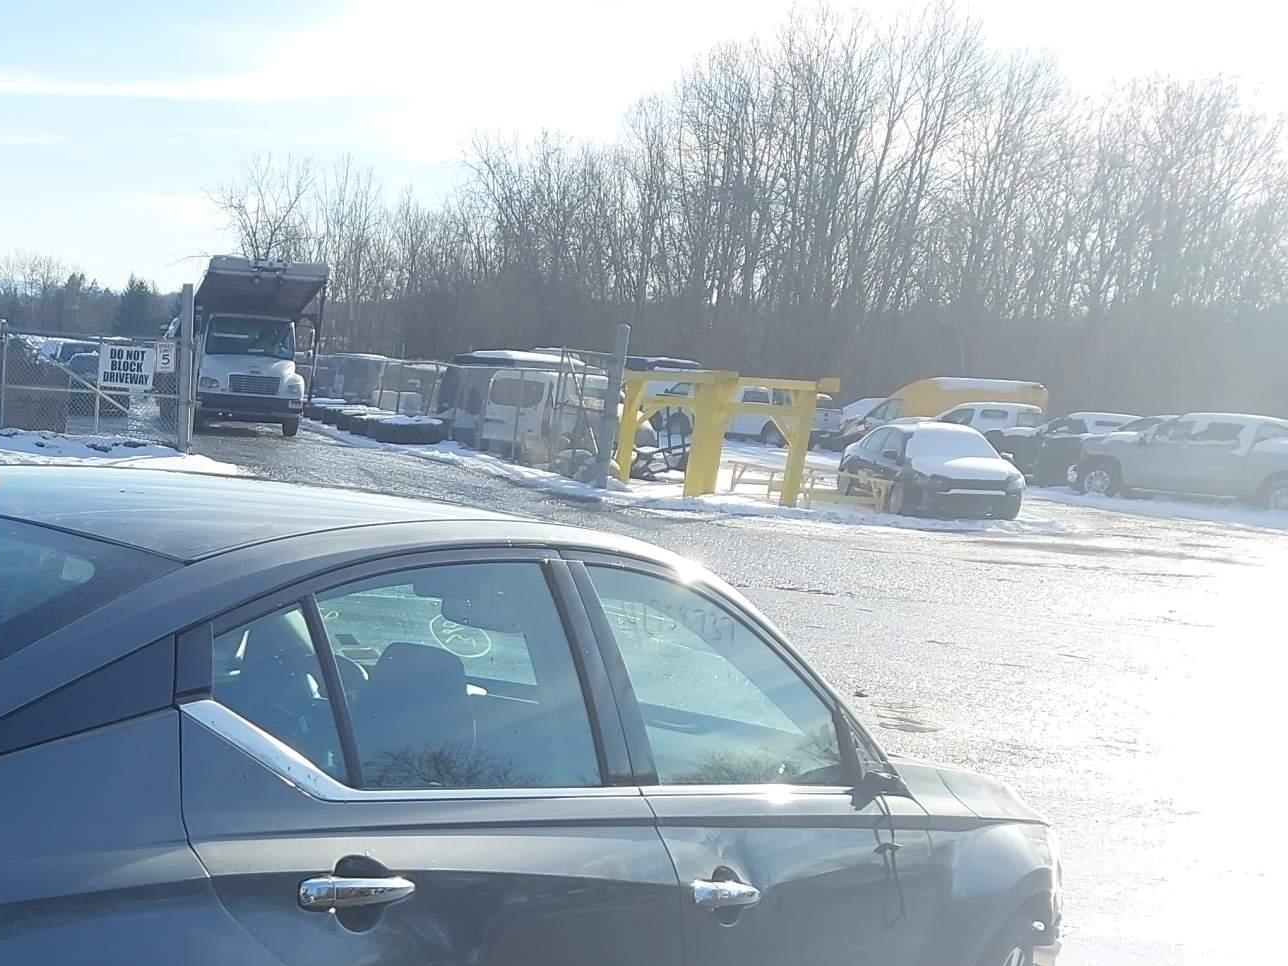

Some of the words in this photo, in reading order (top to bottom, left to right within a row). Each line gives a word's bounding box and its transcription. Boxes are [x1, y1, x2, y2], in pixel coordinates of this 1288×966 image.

[110, 348, 123, 360] DO
[127, 350, 146, 361] NOT
[162, 354, 170, 365] 5
[111, 360, 143, 373] BLOCK
[103, 371, 149, 385] DRIVEWAY
